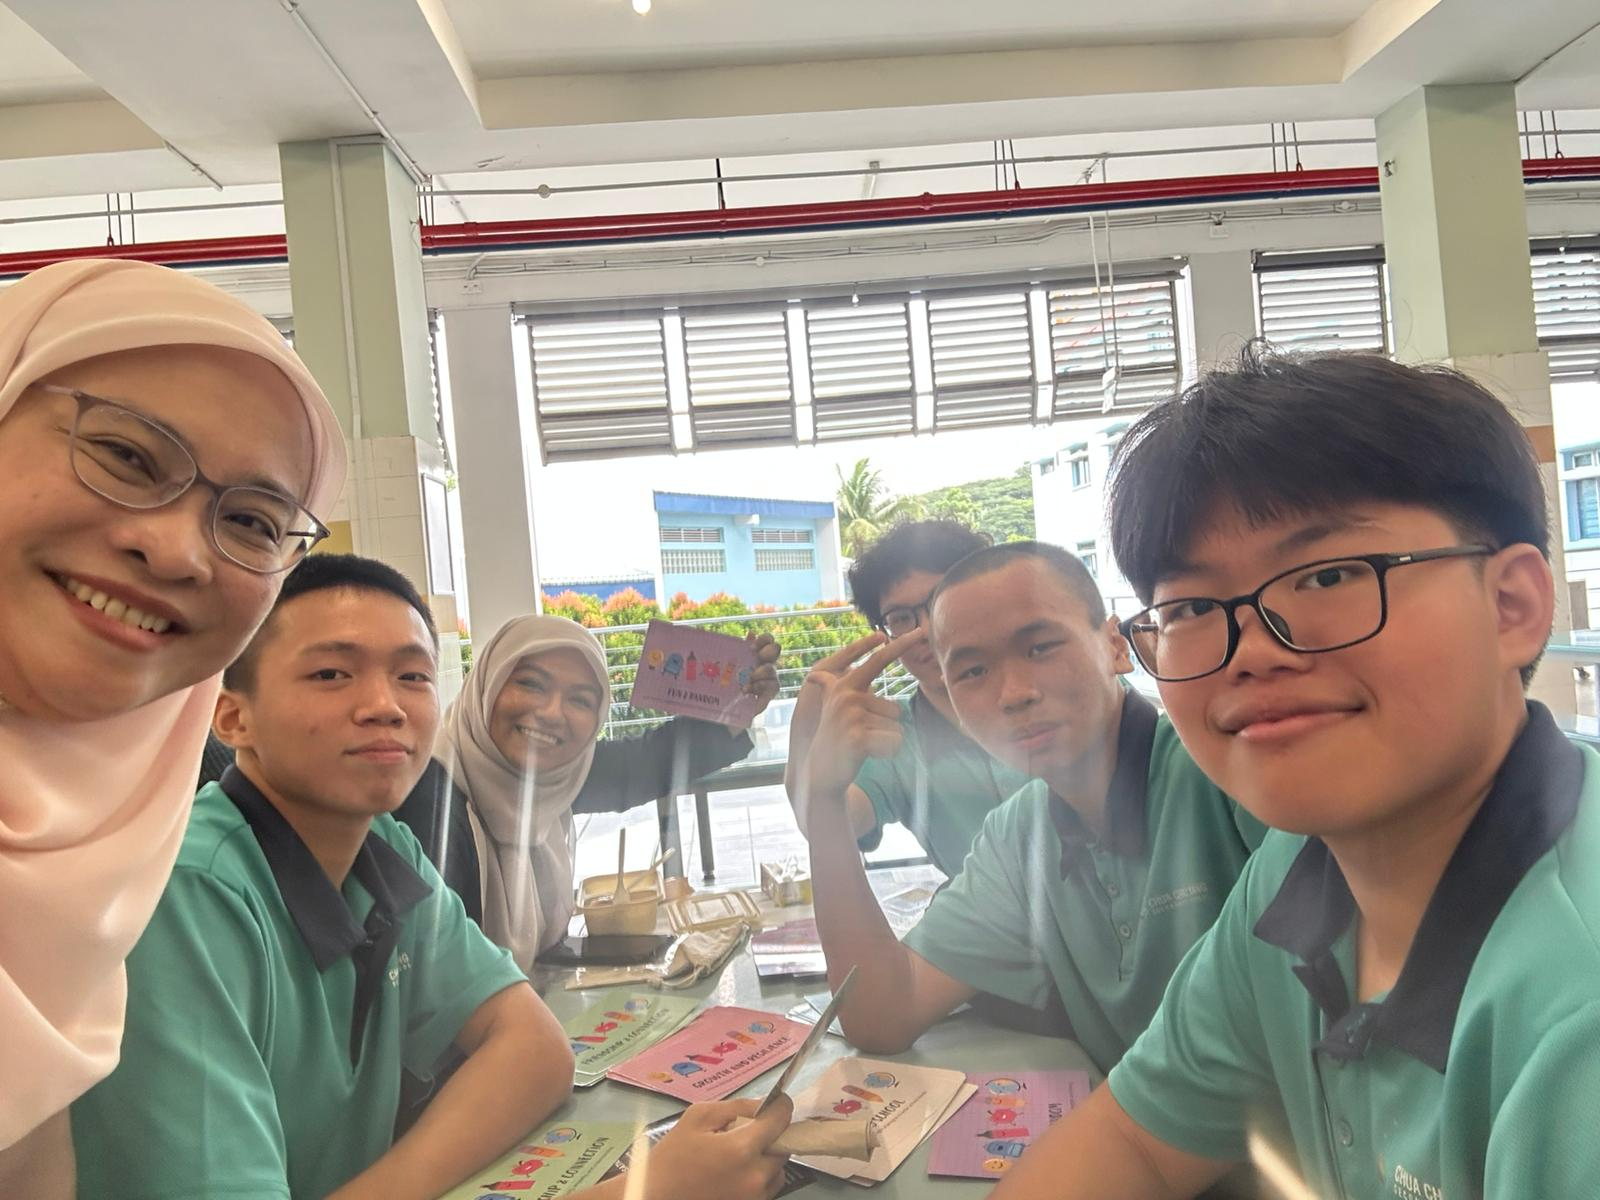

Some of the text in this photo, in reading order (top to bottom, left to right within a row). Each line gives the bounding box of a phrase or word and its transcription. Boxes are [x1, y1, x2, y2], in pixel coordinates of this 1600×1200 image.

[692, 1066, 732, 1089] GROWTH
[561, 1136, 609, 1180] CONNECTION
[1394, 1164, 1422, 1196] CHUA
